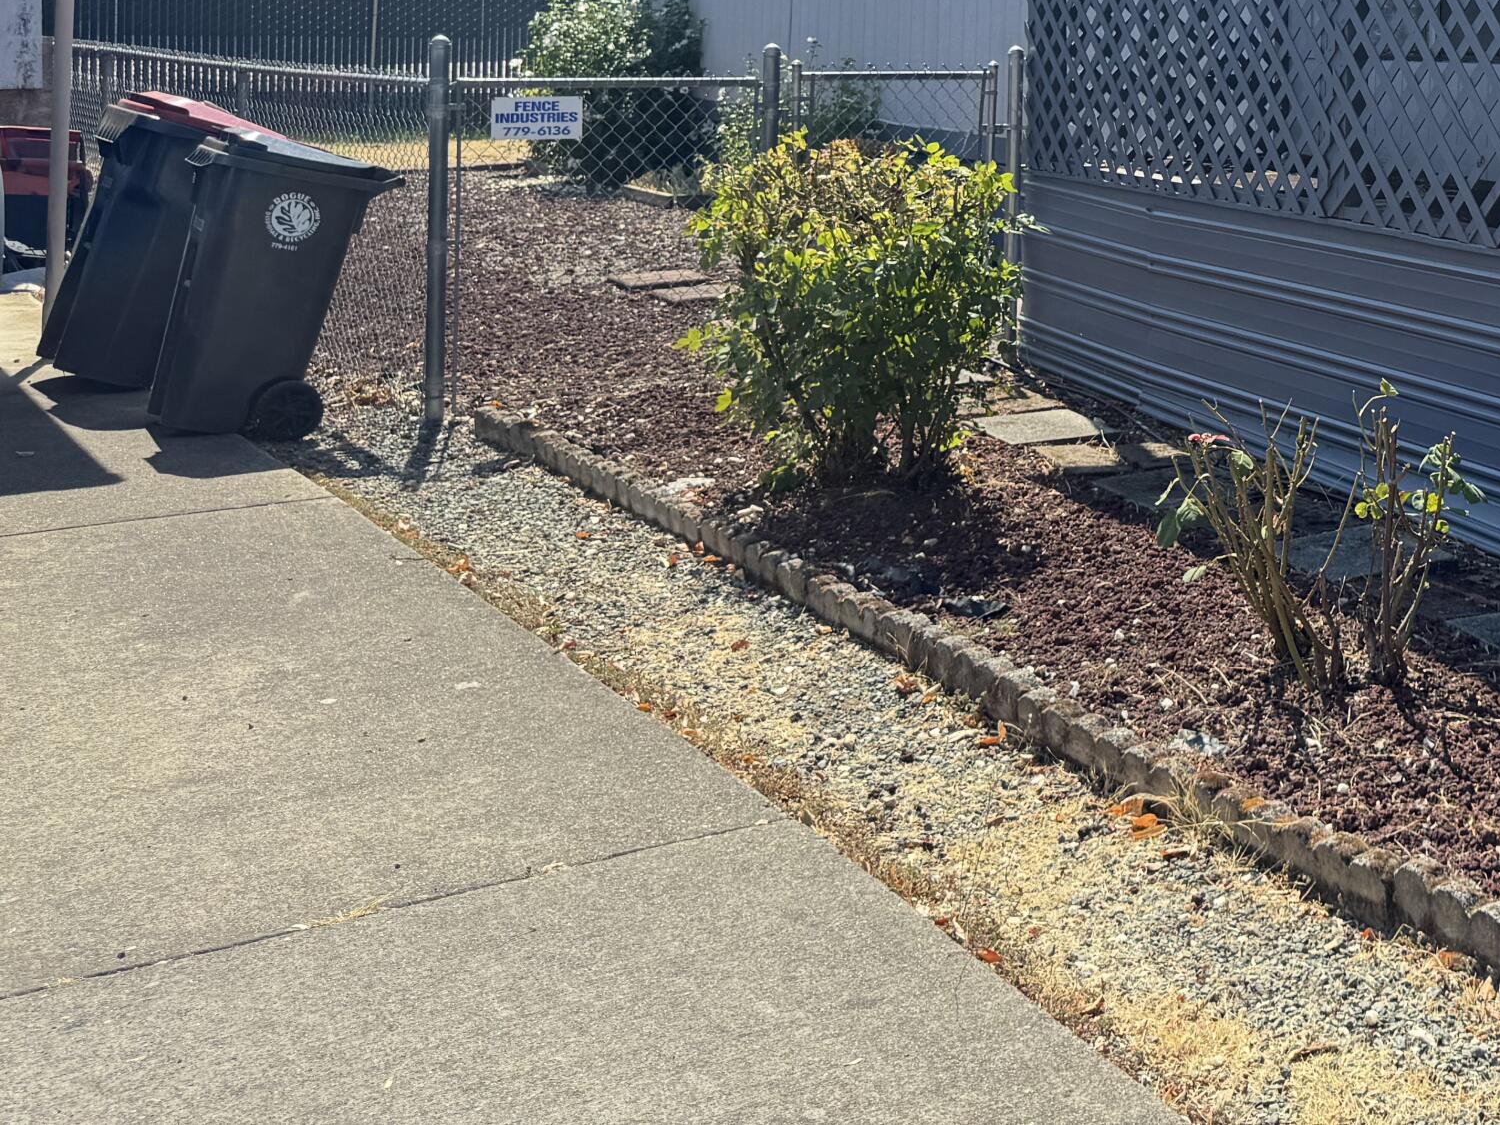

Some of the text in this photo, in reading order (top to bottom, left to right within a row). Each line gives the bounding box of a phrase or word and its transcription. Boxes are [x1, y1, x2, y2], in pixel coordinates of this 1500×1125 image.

[514, 100, 560, 112] FENCE
[495, 111, 578, 124] INDUSTRIES
[503, 126, 571, 136] 779-6136
[273, 192, 312, 205] ROGUE
